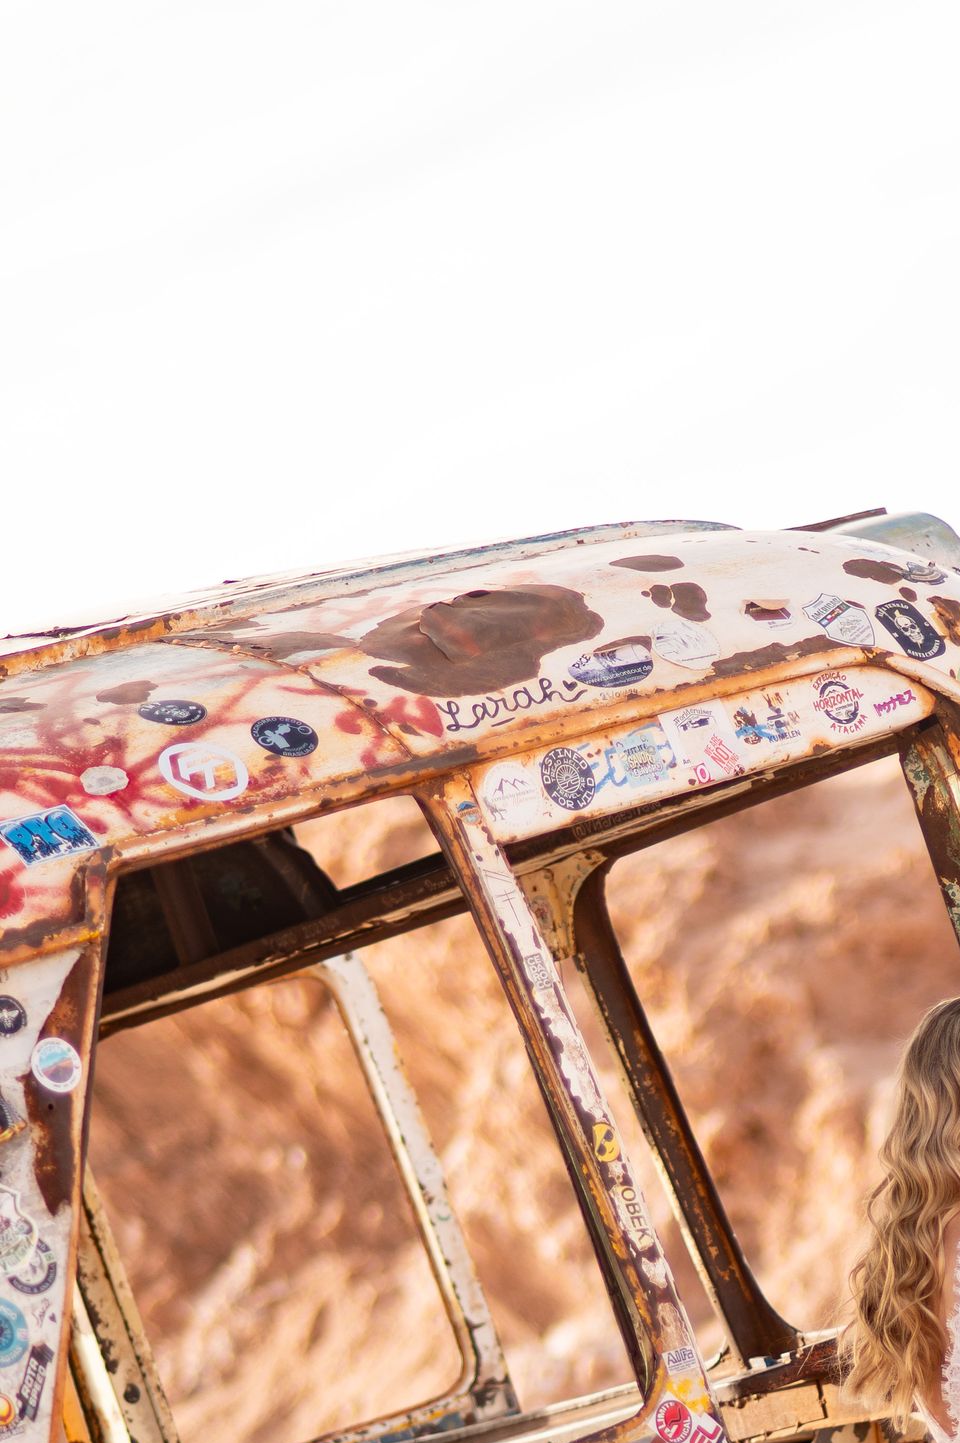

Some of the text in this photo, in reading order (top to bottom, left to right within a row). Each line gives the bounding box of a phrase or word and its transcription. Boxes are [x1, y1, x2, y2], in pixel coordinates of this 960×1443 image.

[813, 687, 864, 712] HORIZONTAL
[831, 713, 868, 735] ATACAMA
[543, 749, 588, 785] DESTINED
[711, 740, 733, 770] NOT
[551, 777, 595, 809] FOR WILD
[658, 1401, 675, 1430] LIMITE
